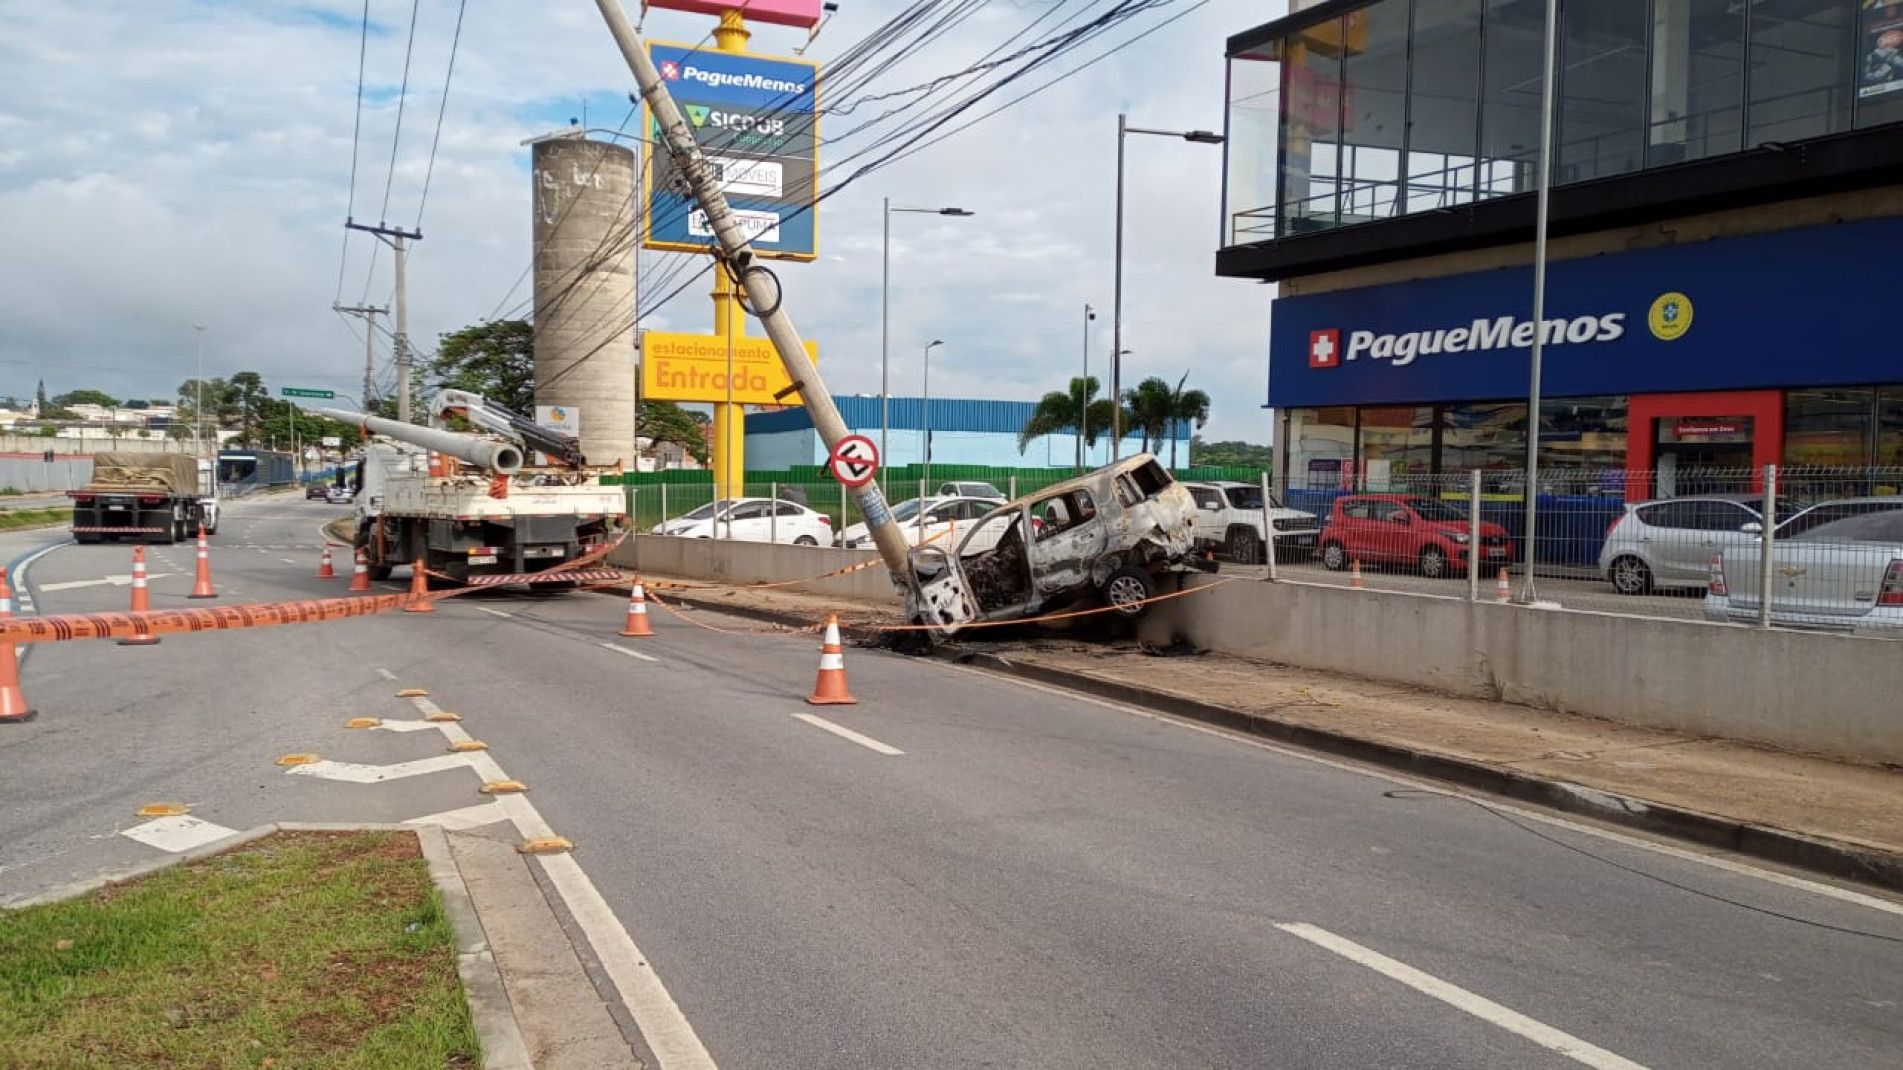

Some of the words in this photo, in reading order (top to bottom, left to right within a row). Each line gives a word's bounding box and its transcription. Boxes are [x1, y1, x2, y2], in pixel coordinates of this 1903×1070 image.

[683, 66, 805, 94] PagueMenos
[652, 342, 771, 359] estacionamento
[1346, 313, 1626, 366] PagueMenos
[656, 360, 767, 392] Entrada
